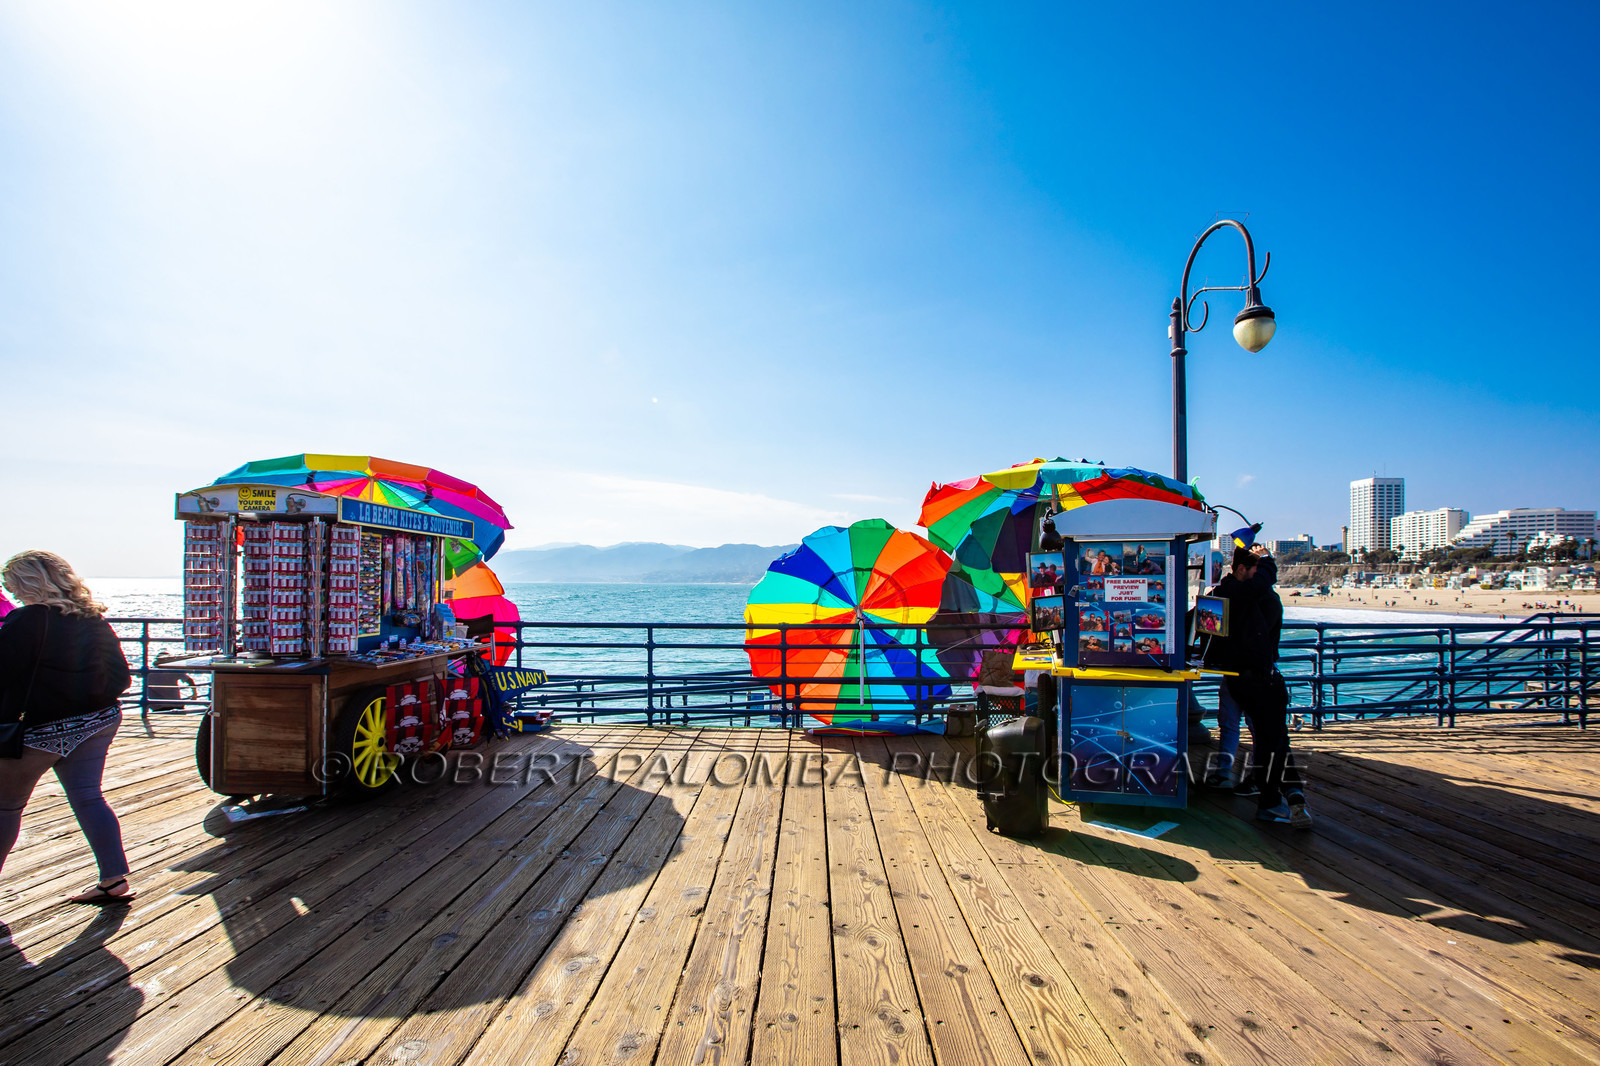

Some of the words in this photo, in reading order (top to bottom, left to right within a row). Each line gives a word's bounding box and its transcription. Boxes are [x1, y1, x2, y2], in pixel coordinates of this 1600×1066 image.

[252, 489, 276, 498] SMILE
[359, 503, 371, 522] LA
[372, 505, 398, 526] BEACH
[400, 510, 423, 530] KITES
[423, 516, 429, 531] &
[430, 517, 464, 536] SOUVENIRS
